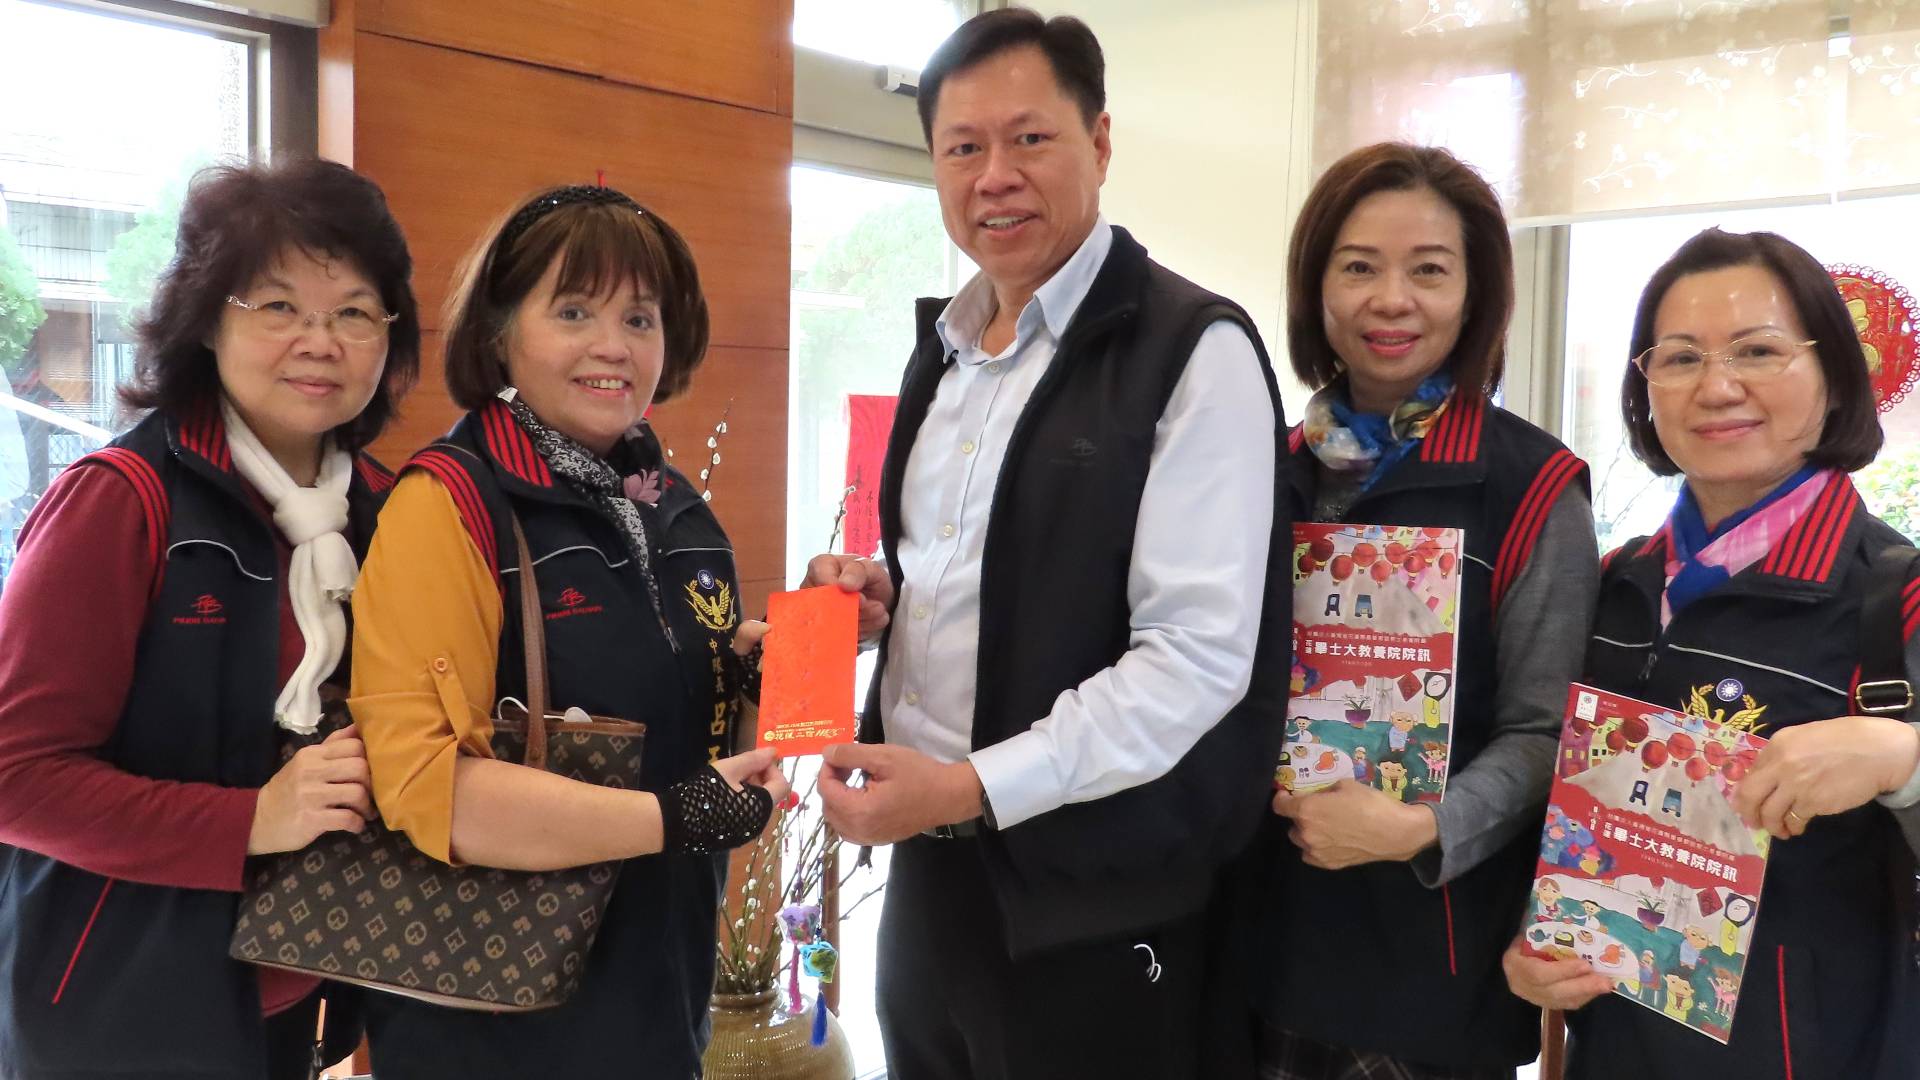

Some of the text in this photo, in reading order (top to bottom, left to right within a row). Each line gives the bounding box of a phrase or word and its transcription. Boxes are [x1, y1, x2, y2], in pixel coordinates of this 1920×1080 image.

[1314, 641, 1431, 662] 畢士大教養院院訊
[1613, 826, 1738, 883] 畢士大教養院院訊
